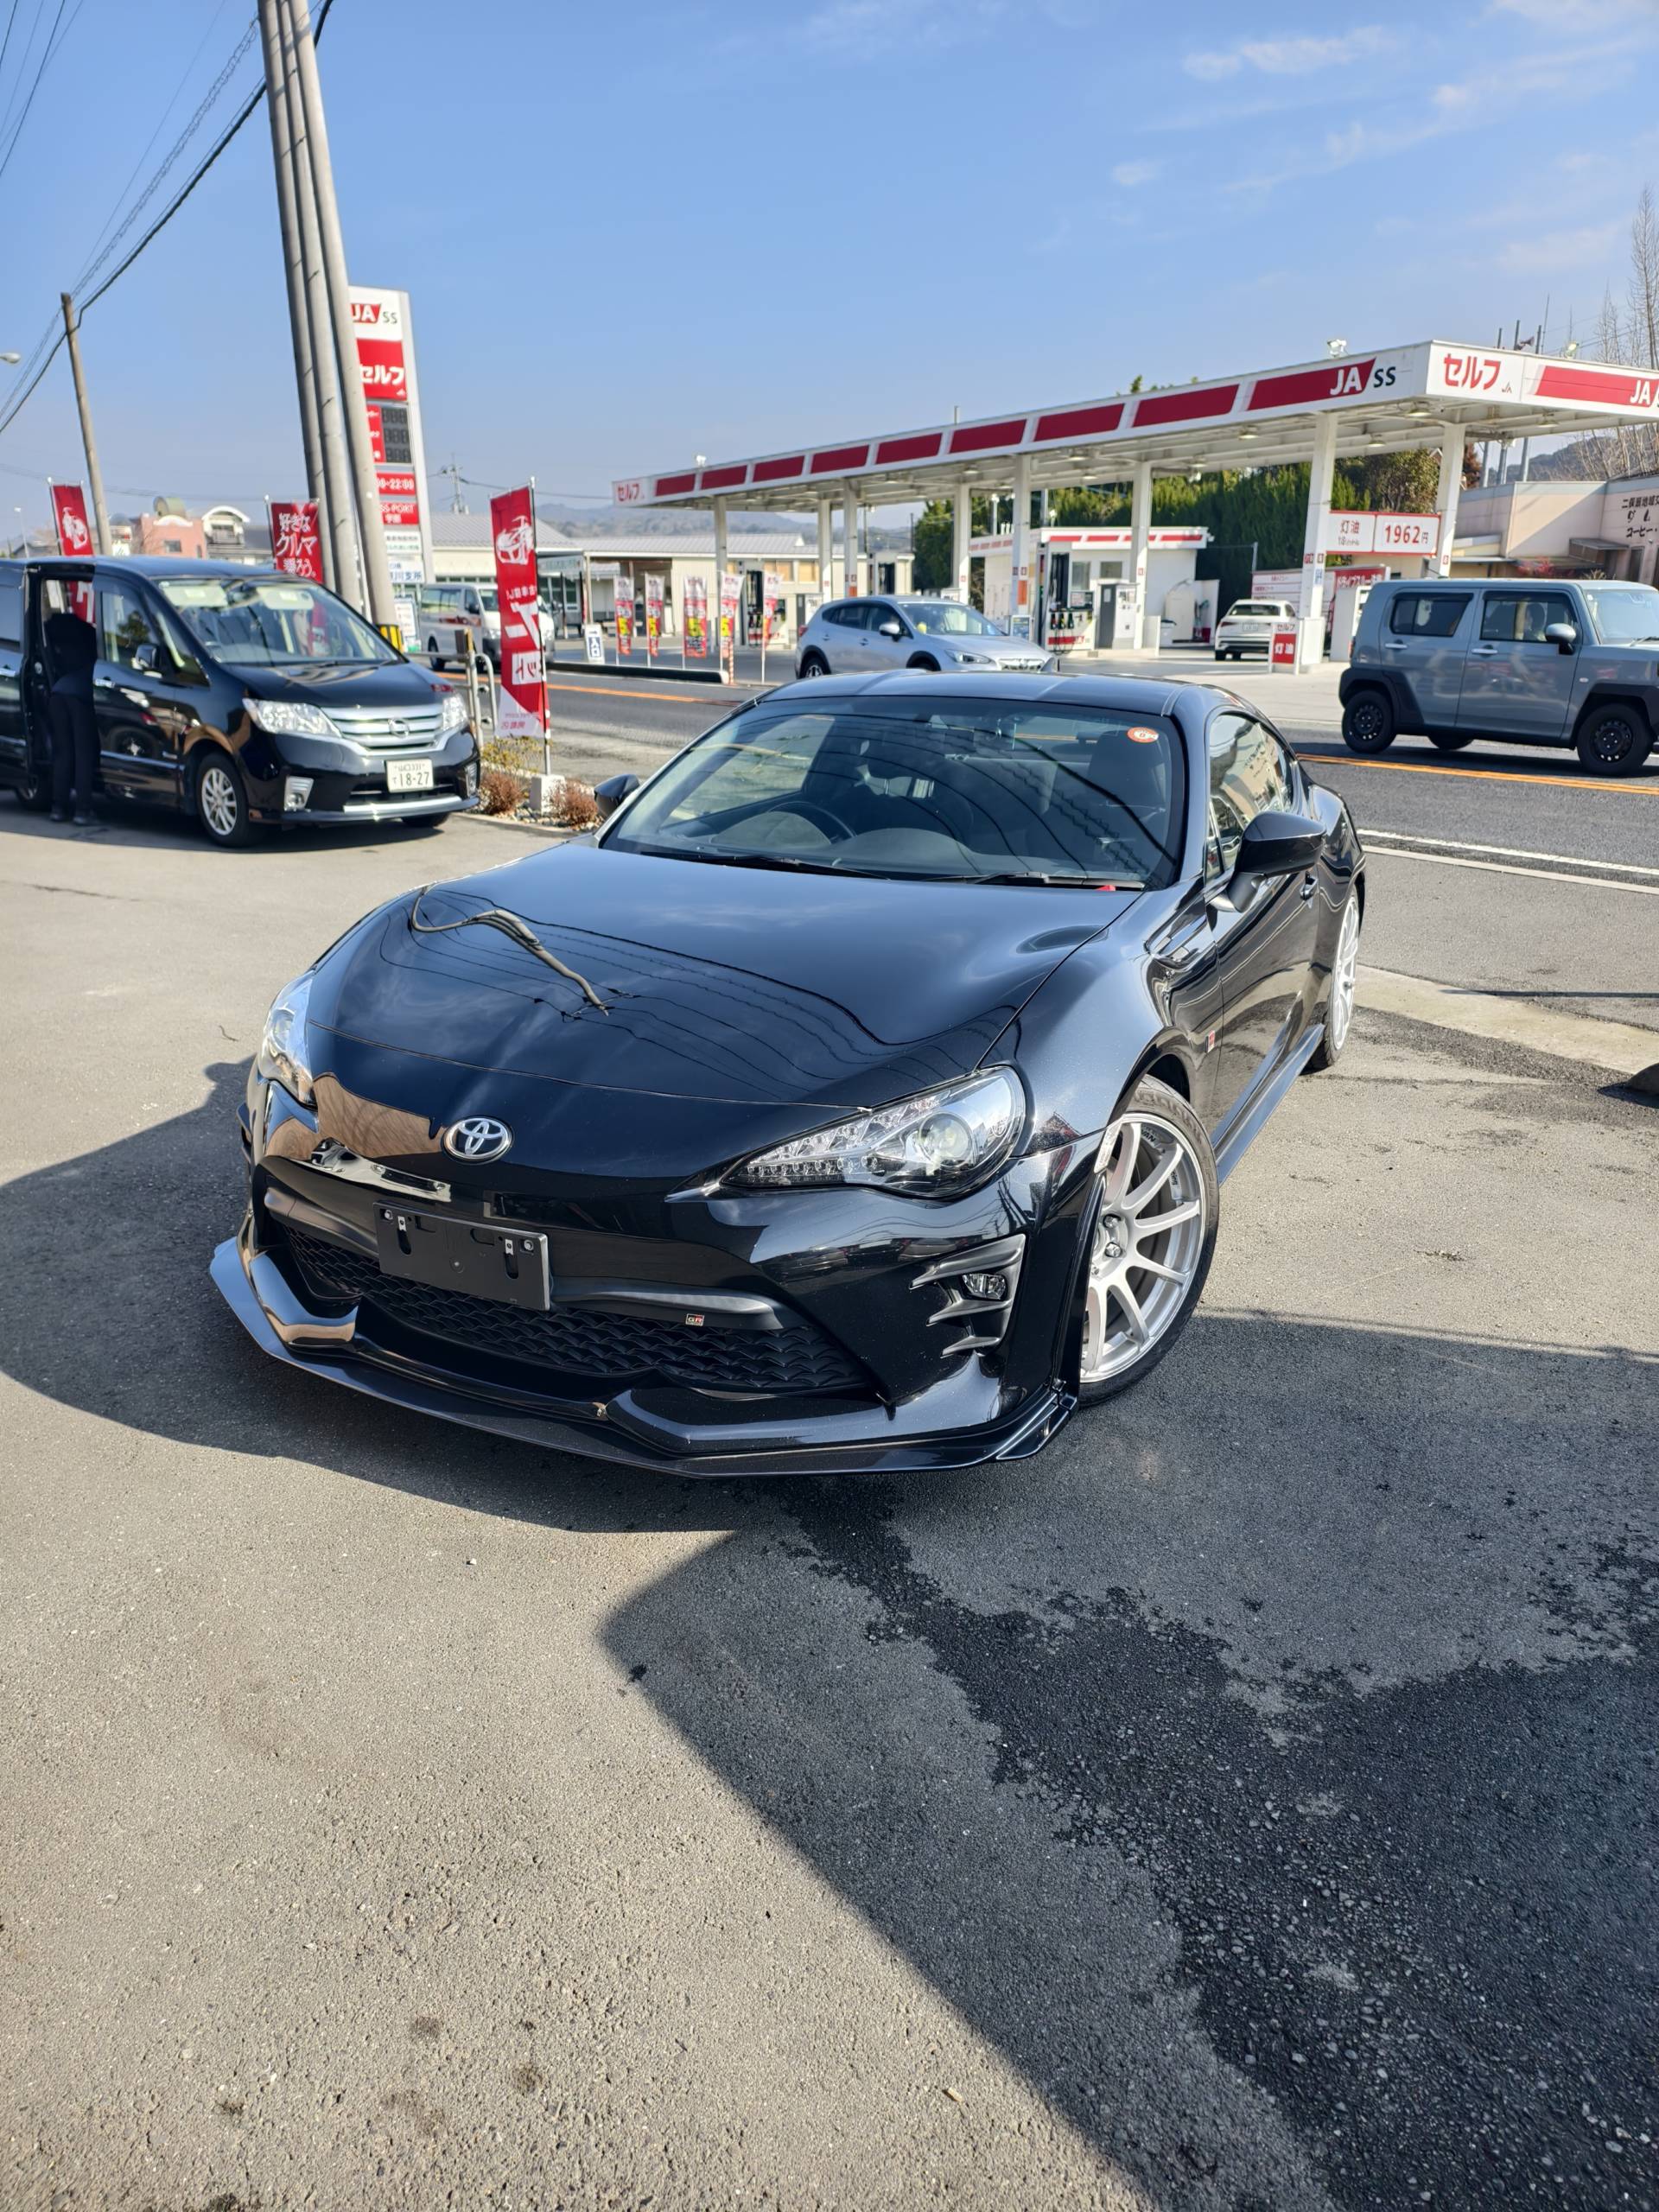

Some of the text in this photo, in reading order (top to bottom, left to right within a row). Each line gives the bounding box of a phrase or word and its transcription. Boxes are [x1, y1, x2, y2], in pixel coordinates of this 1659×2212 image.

[353, 303, 397, 324] JA SS
[359, 364, 404, 385] セルフ
[1330, 366, 1396, 395] JA SS
[1443, 353, 1501, 390] セルフ
[1630, 379, 1650, 404] JA
[276, 532, 318, 556] クルマ
[399, 772, 429, 787] 18-27
